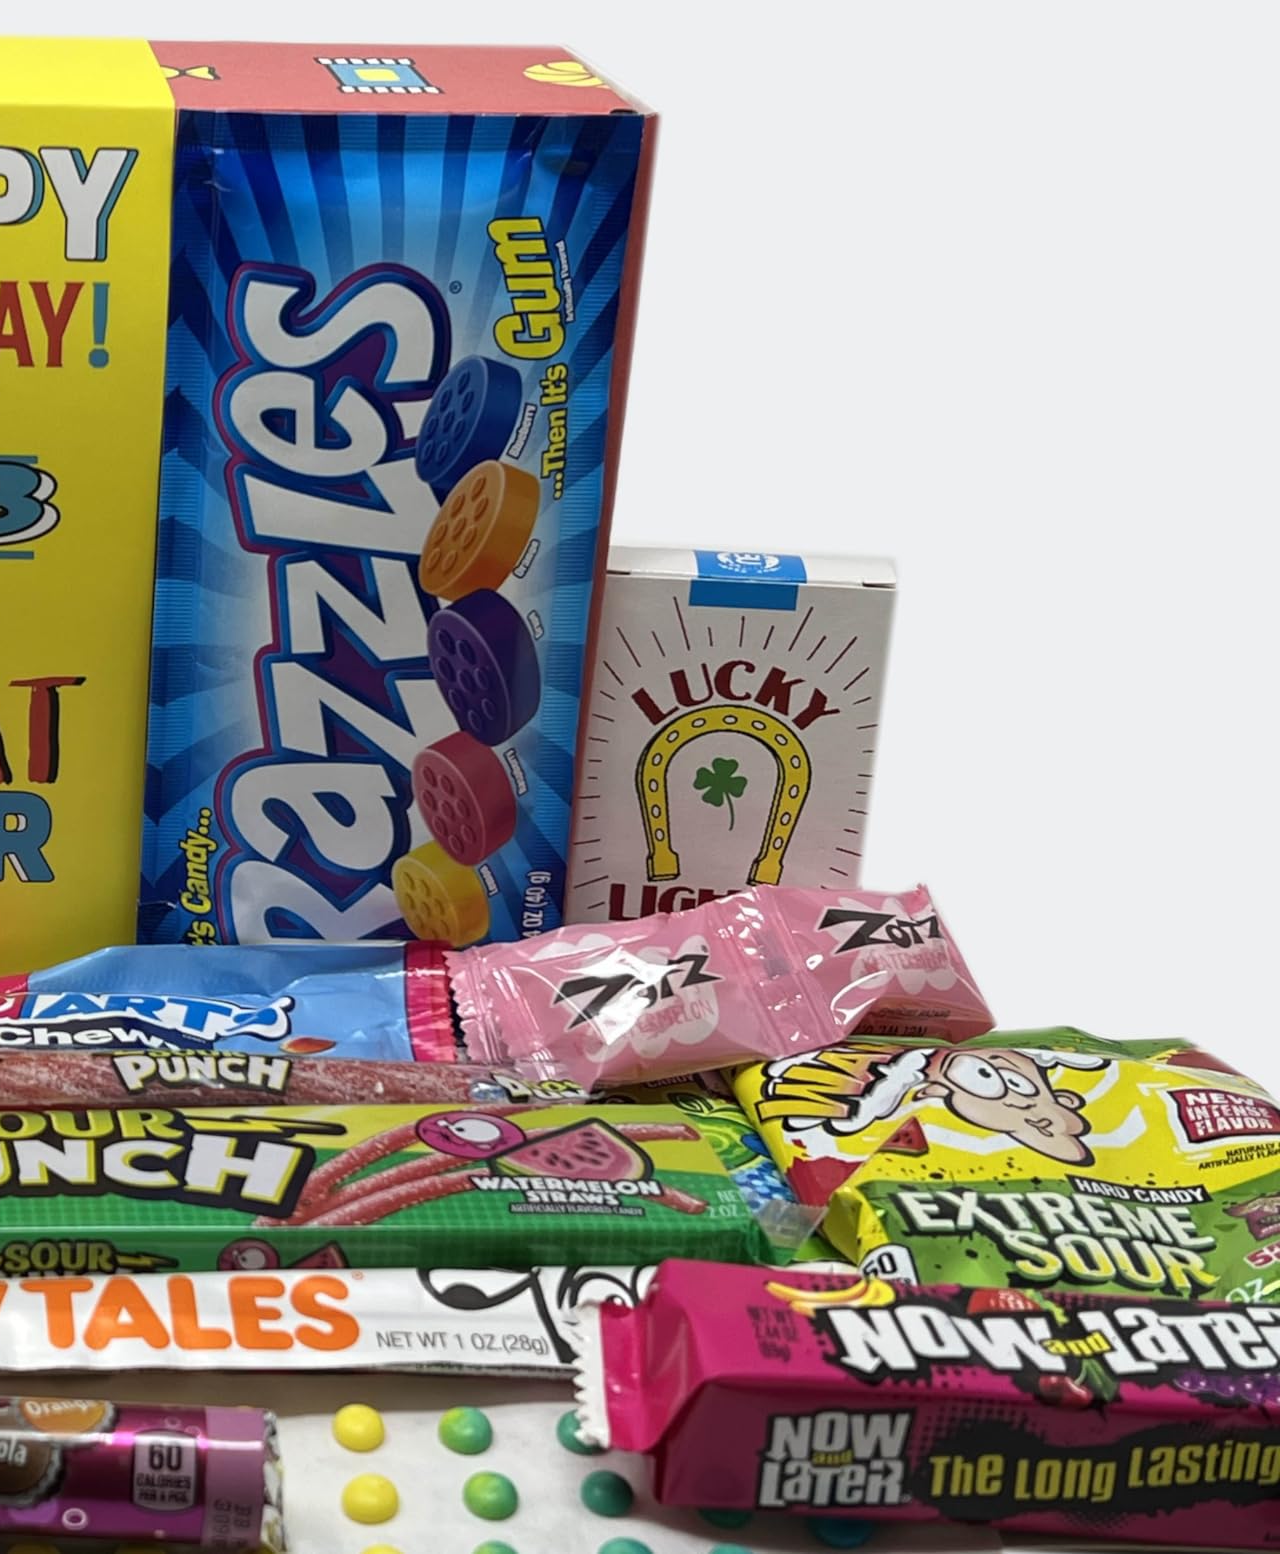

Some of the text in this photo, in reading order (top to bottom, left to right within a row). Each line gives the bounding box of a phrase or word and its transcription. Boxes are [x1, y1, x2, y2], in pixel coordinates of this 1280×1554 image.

[487, 217, 566, 359] Gum
[540, 364, 568, 406] It's
[228, 278, 460, 944] Razzles
[631, 660, 840, 730] LUCKY
[608, 884, 744, 920] LIG
[522, 909, 544, 927] OZ
[114, 1055, 290, 1091] PUNCH
[1185, 1092, 1255, 1106] NEW
[1187, 1106, 1271, 1120] INTENSE
[1195, 1116, 1273, 1136] FLAVOR
[1199, 1153, 1256, 1170] ARTIFICIALLY
[1226, 1141, 1275, 1158] NATURALLY
[471, 1176, 662, 1196] WATERMELON
[525, 1190, 619, 1206] STRAWS
[1076, 1180, 1205, 1204] HARD CANDY
[903, 1190, 1216, 1251] EXTREME
[3, 1242, 116, 1271] SOUR
[1008, 1230, 1222, 1298] SOUR
[21, 1275, 361, 1351] TALES
[376, 1332, 416, 1348] NET
[418, 1333, 448, 1349] WT
[454, 1333, 461, 1349] 1
[828, 1304, 1068, 1374] NOW
[1040, 1331, 1113, 1358] and
[765, 1411, 911, 1461] NOW
[149, 1441, 182, 1471] 60
[136, 1473, 192, 1490] CALORIES
[929, 1453, 1005, 1498] The
